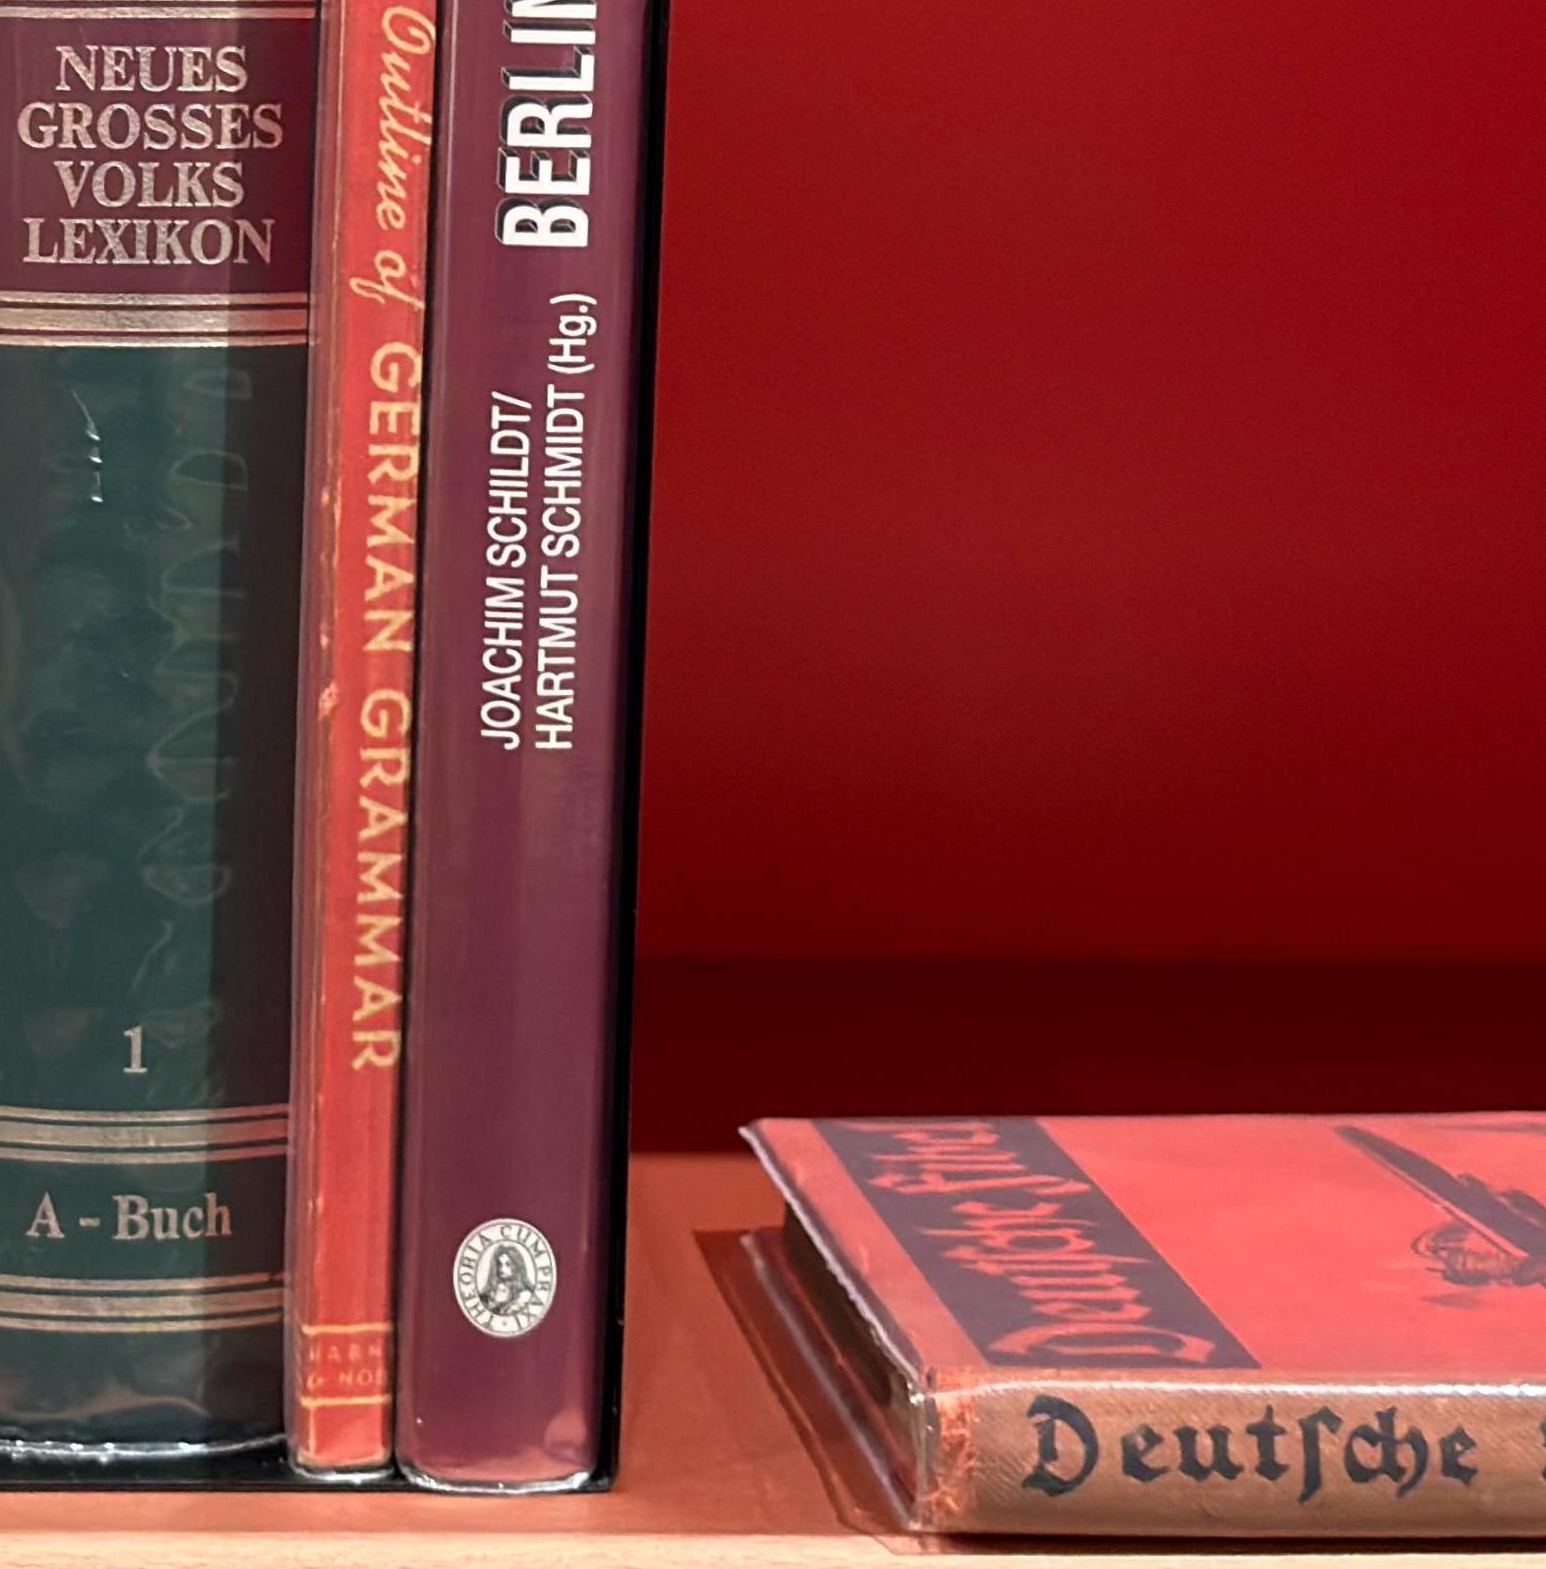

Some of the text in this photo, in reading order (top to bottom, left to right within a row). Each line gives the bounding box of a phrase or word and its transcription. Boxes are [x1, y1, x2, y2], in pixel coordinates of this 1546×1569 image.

[54, 44, 248, 93] NEUES
[17, 101, 285, 151] GROSSES
[375, 5, 437, 231] Outline
[53, 160, 246, 209] VOLKS
[22, 216, 276, 267] LEXIKON
[349, 249, 426, 311] of
[362, 341, 424, 653] GERMAN
[535, 293, 599, 751] HARTMUT SCHMIDT (Hg.)
[480, 390, 535, 752] JOACHIM SCHILDT/
[351, 688, 413, 1073] GRAMMAR
[123, 1025, 149, 1075] 1
[25, 1191, 65, 1240] A
[111, 1192, 234, 1242] Buch
